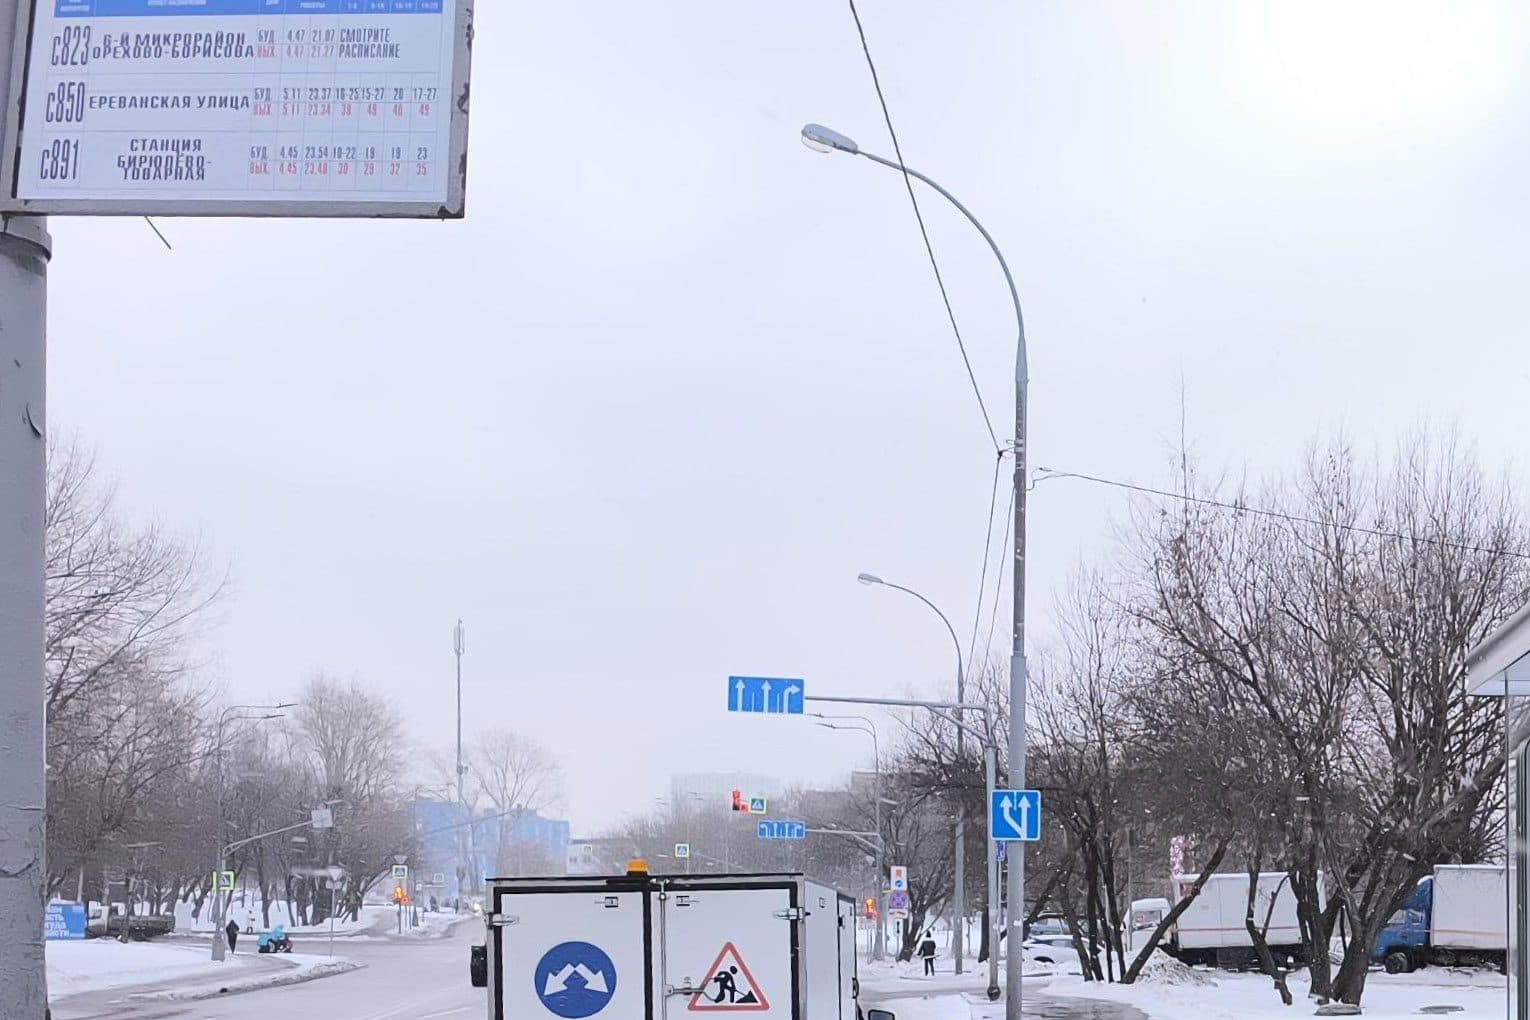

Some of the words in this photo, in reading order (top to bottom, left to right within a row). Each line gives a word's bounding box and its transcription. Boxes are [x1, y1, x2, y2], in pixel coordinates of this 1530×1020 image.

[135, 30, 245, 46] МИКРОРАЙОН
[340, 28, 390, 43] СМОТРИТЕ
[51, 25, 91, 66] с823
[338, 43, 400, 58] РАСПИСАНИЕ
[46, 81, 86, 123] с850
[89, 95, 191, 109] ЕРЕВАНСКАЯ
[197, 95, 250, 111] УЛИЦА
[130, 139, 202, 154] СТАНЦИЯ
[40, 138, 79, 180] с891
[122, 166, 206, 181] ТОВАРНАЯ
